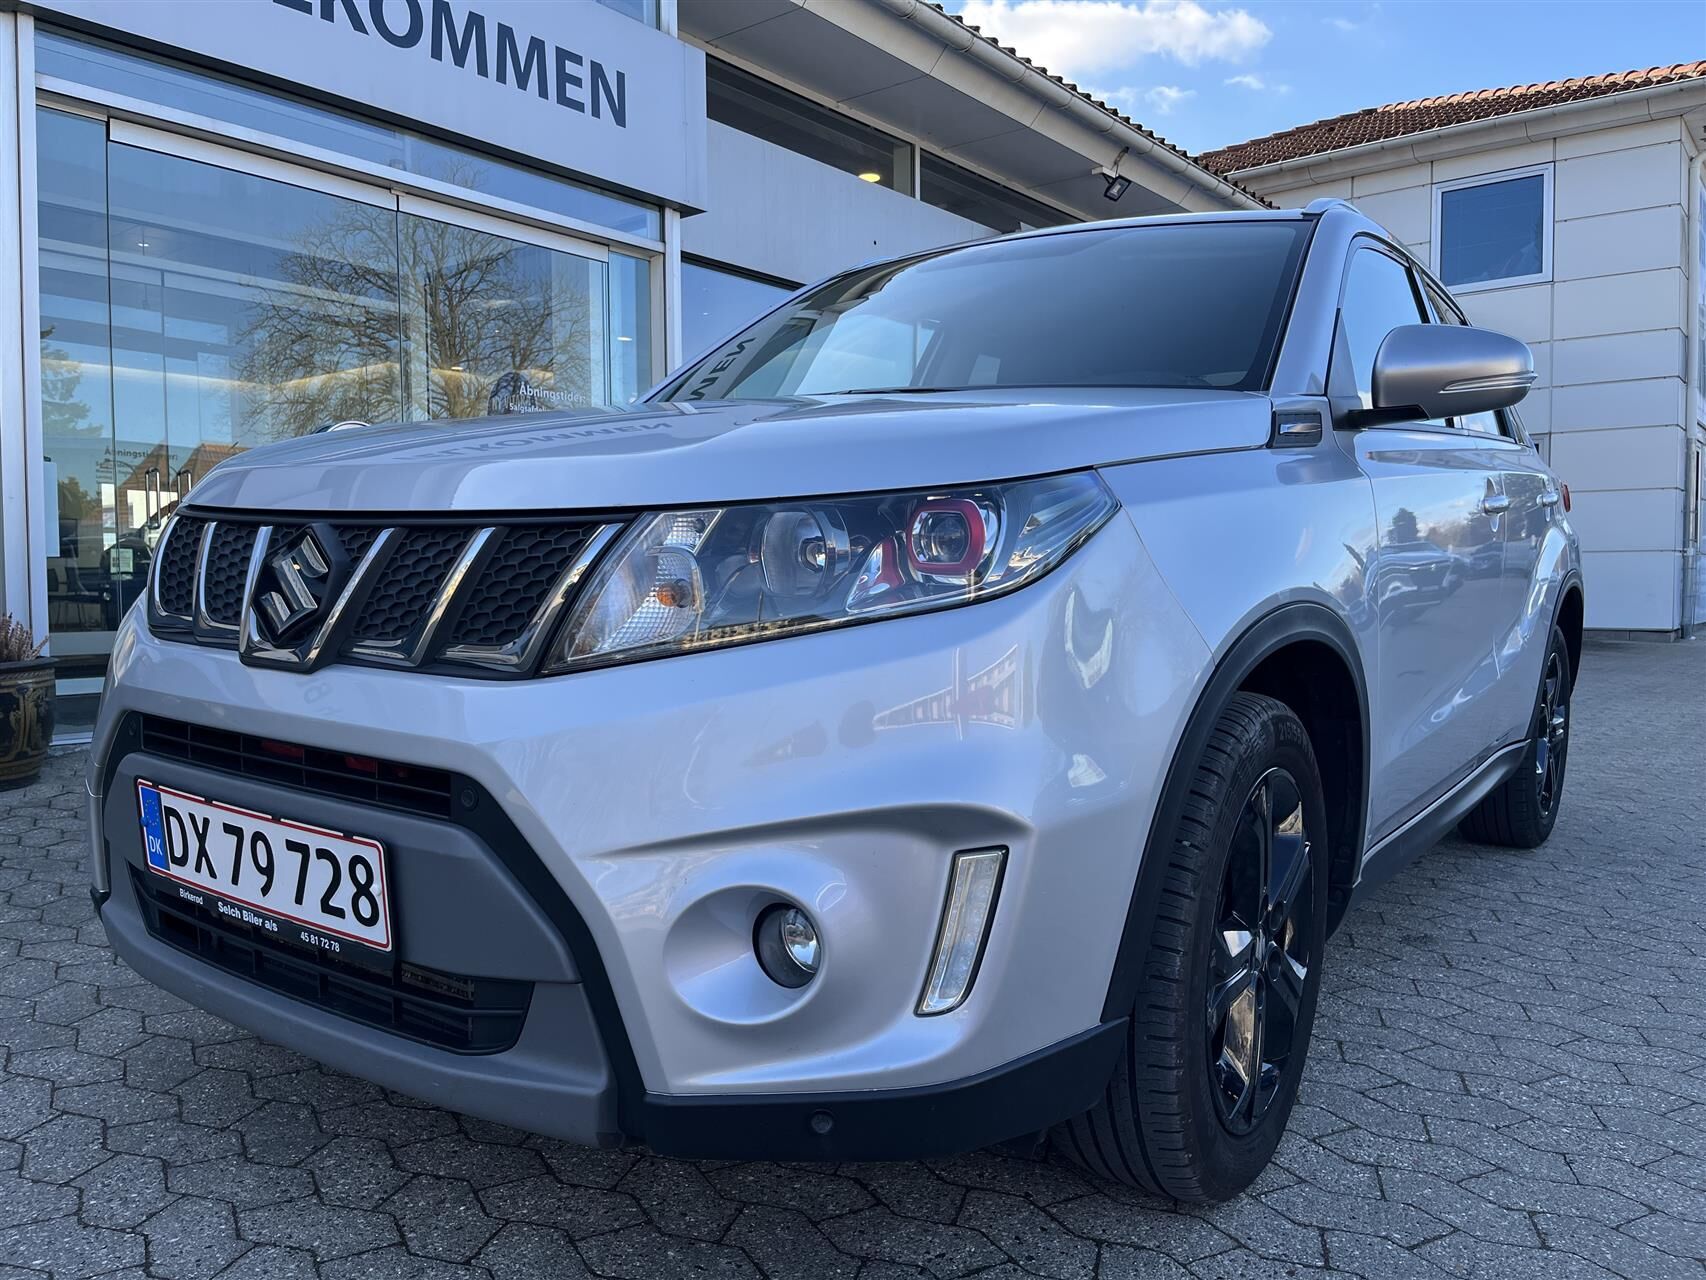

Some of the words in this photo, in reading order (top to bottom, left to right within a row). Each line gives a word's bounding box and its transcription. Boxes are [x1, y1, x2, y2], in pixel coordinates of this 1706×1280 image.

[272, 0, 627, 129] OMMEN
[148, 835, 163, 857] DK
[163, 804, 218, 880] DX
[222, 821, 276, 898] 79
[284, 838, 380, 928] 728
[217, 901, 242, 920] Selch
[242, 909, 263, 927] Biler
[264, 919, 278, 933] a/s
[300, 930, 310, 943] 45
[310, 933, 319, 947] 81
[320, 936, 330, 950] 72
[330, 938, 340, 953] 78
